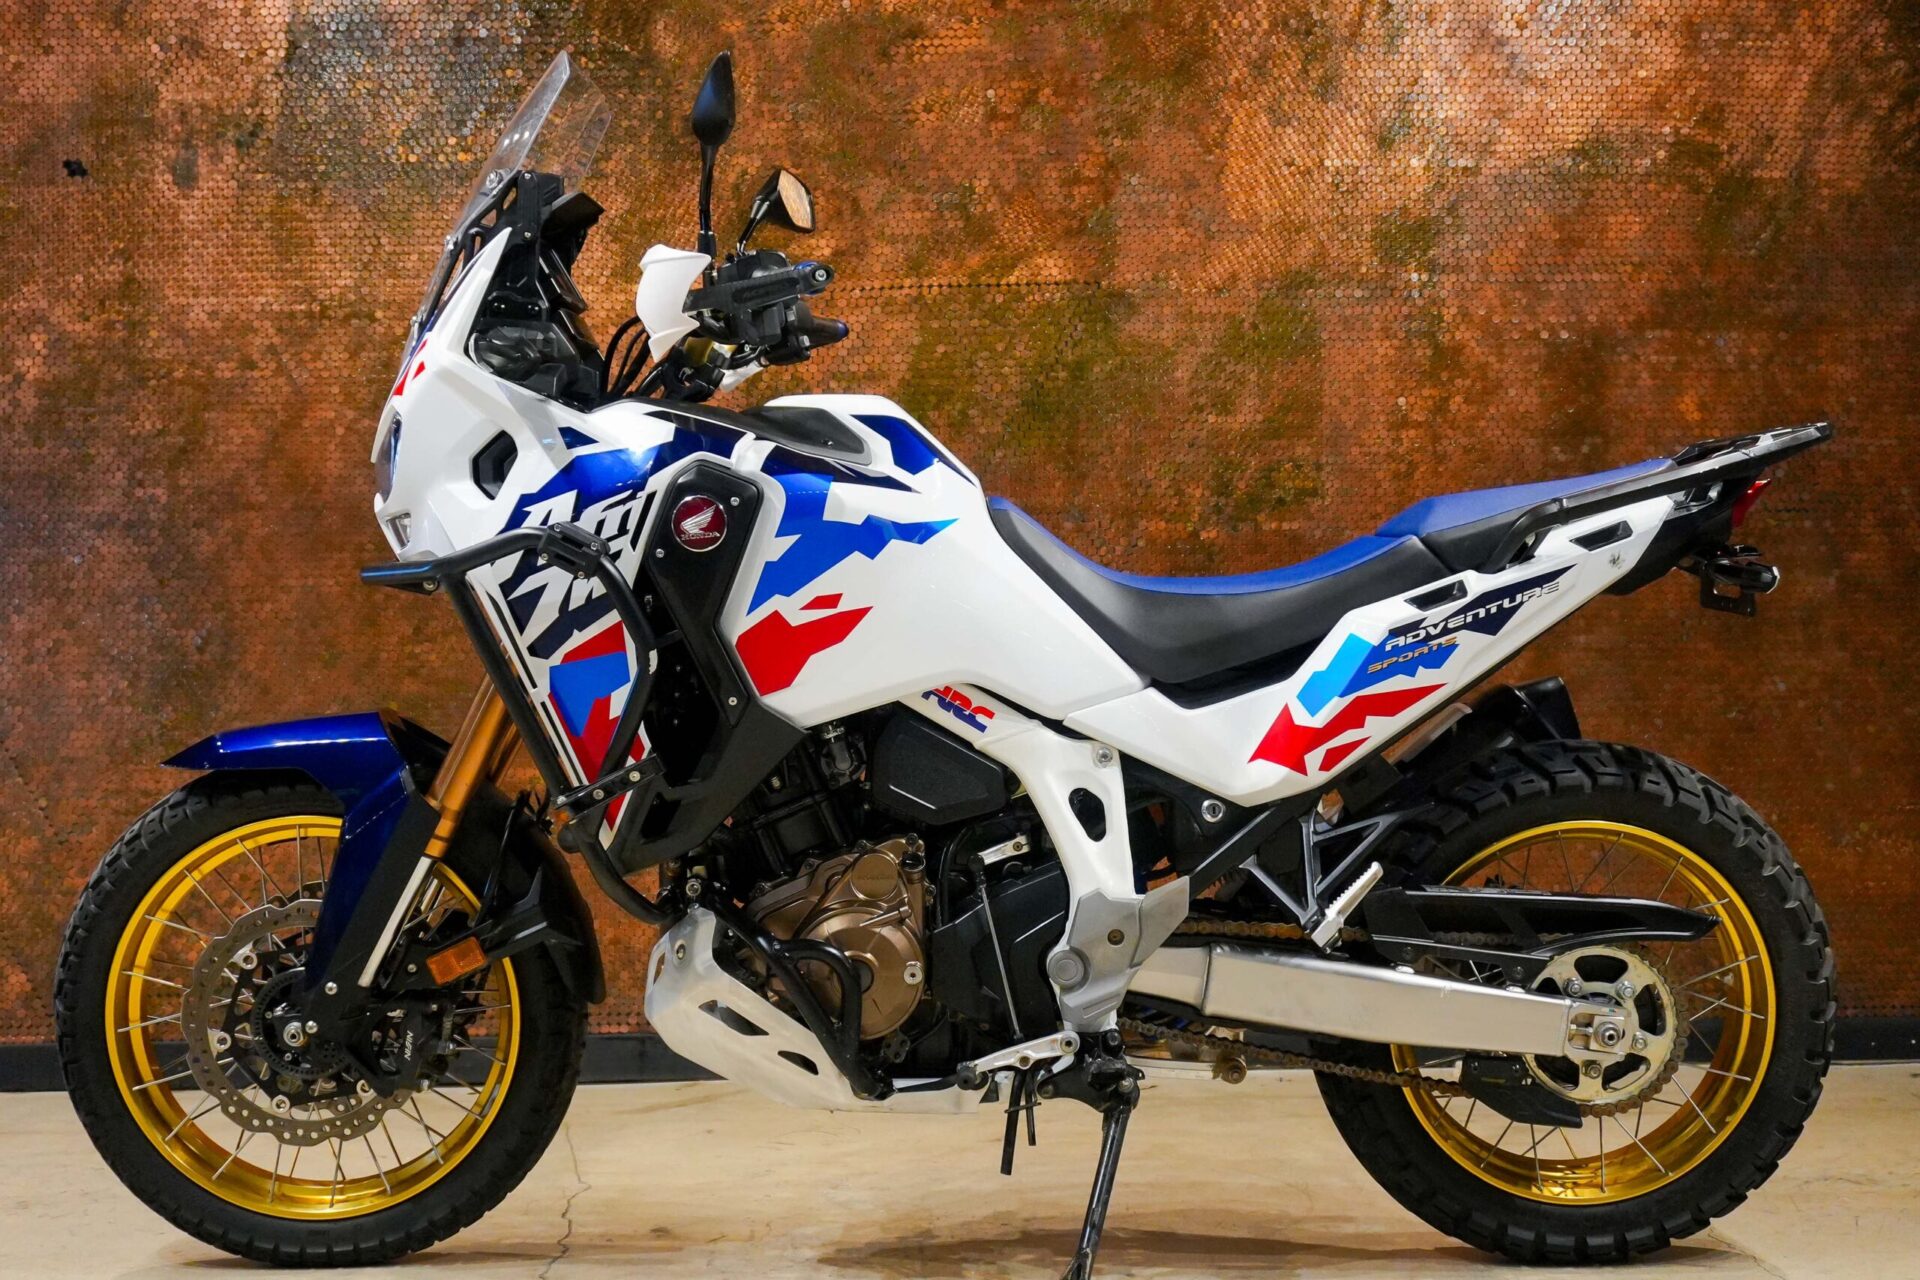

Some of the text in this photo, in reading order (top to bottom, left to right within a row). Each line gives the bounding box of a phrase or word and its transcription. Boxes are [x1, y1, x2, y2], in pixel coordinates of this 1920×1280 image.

[680, 531, 721, 541] HONDA
[1384, 581, 1560, 652] ADVENTURE
[1367, 636, 1458, 674] SPORTS
[921, 685, 996, 734] HRC
